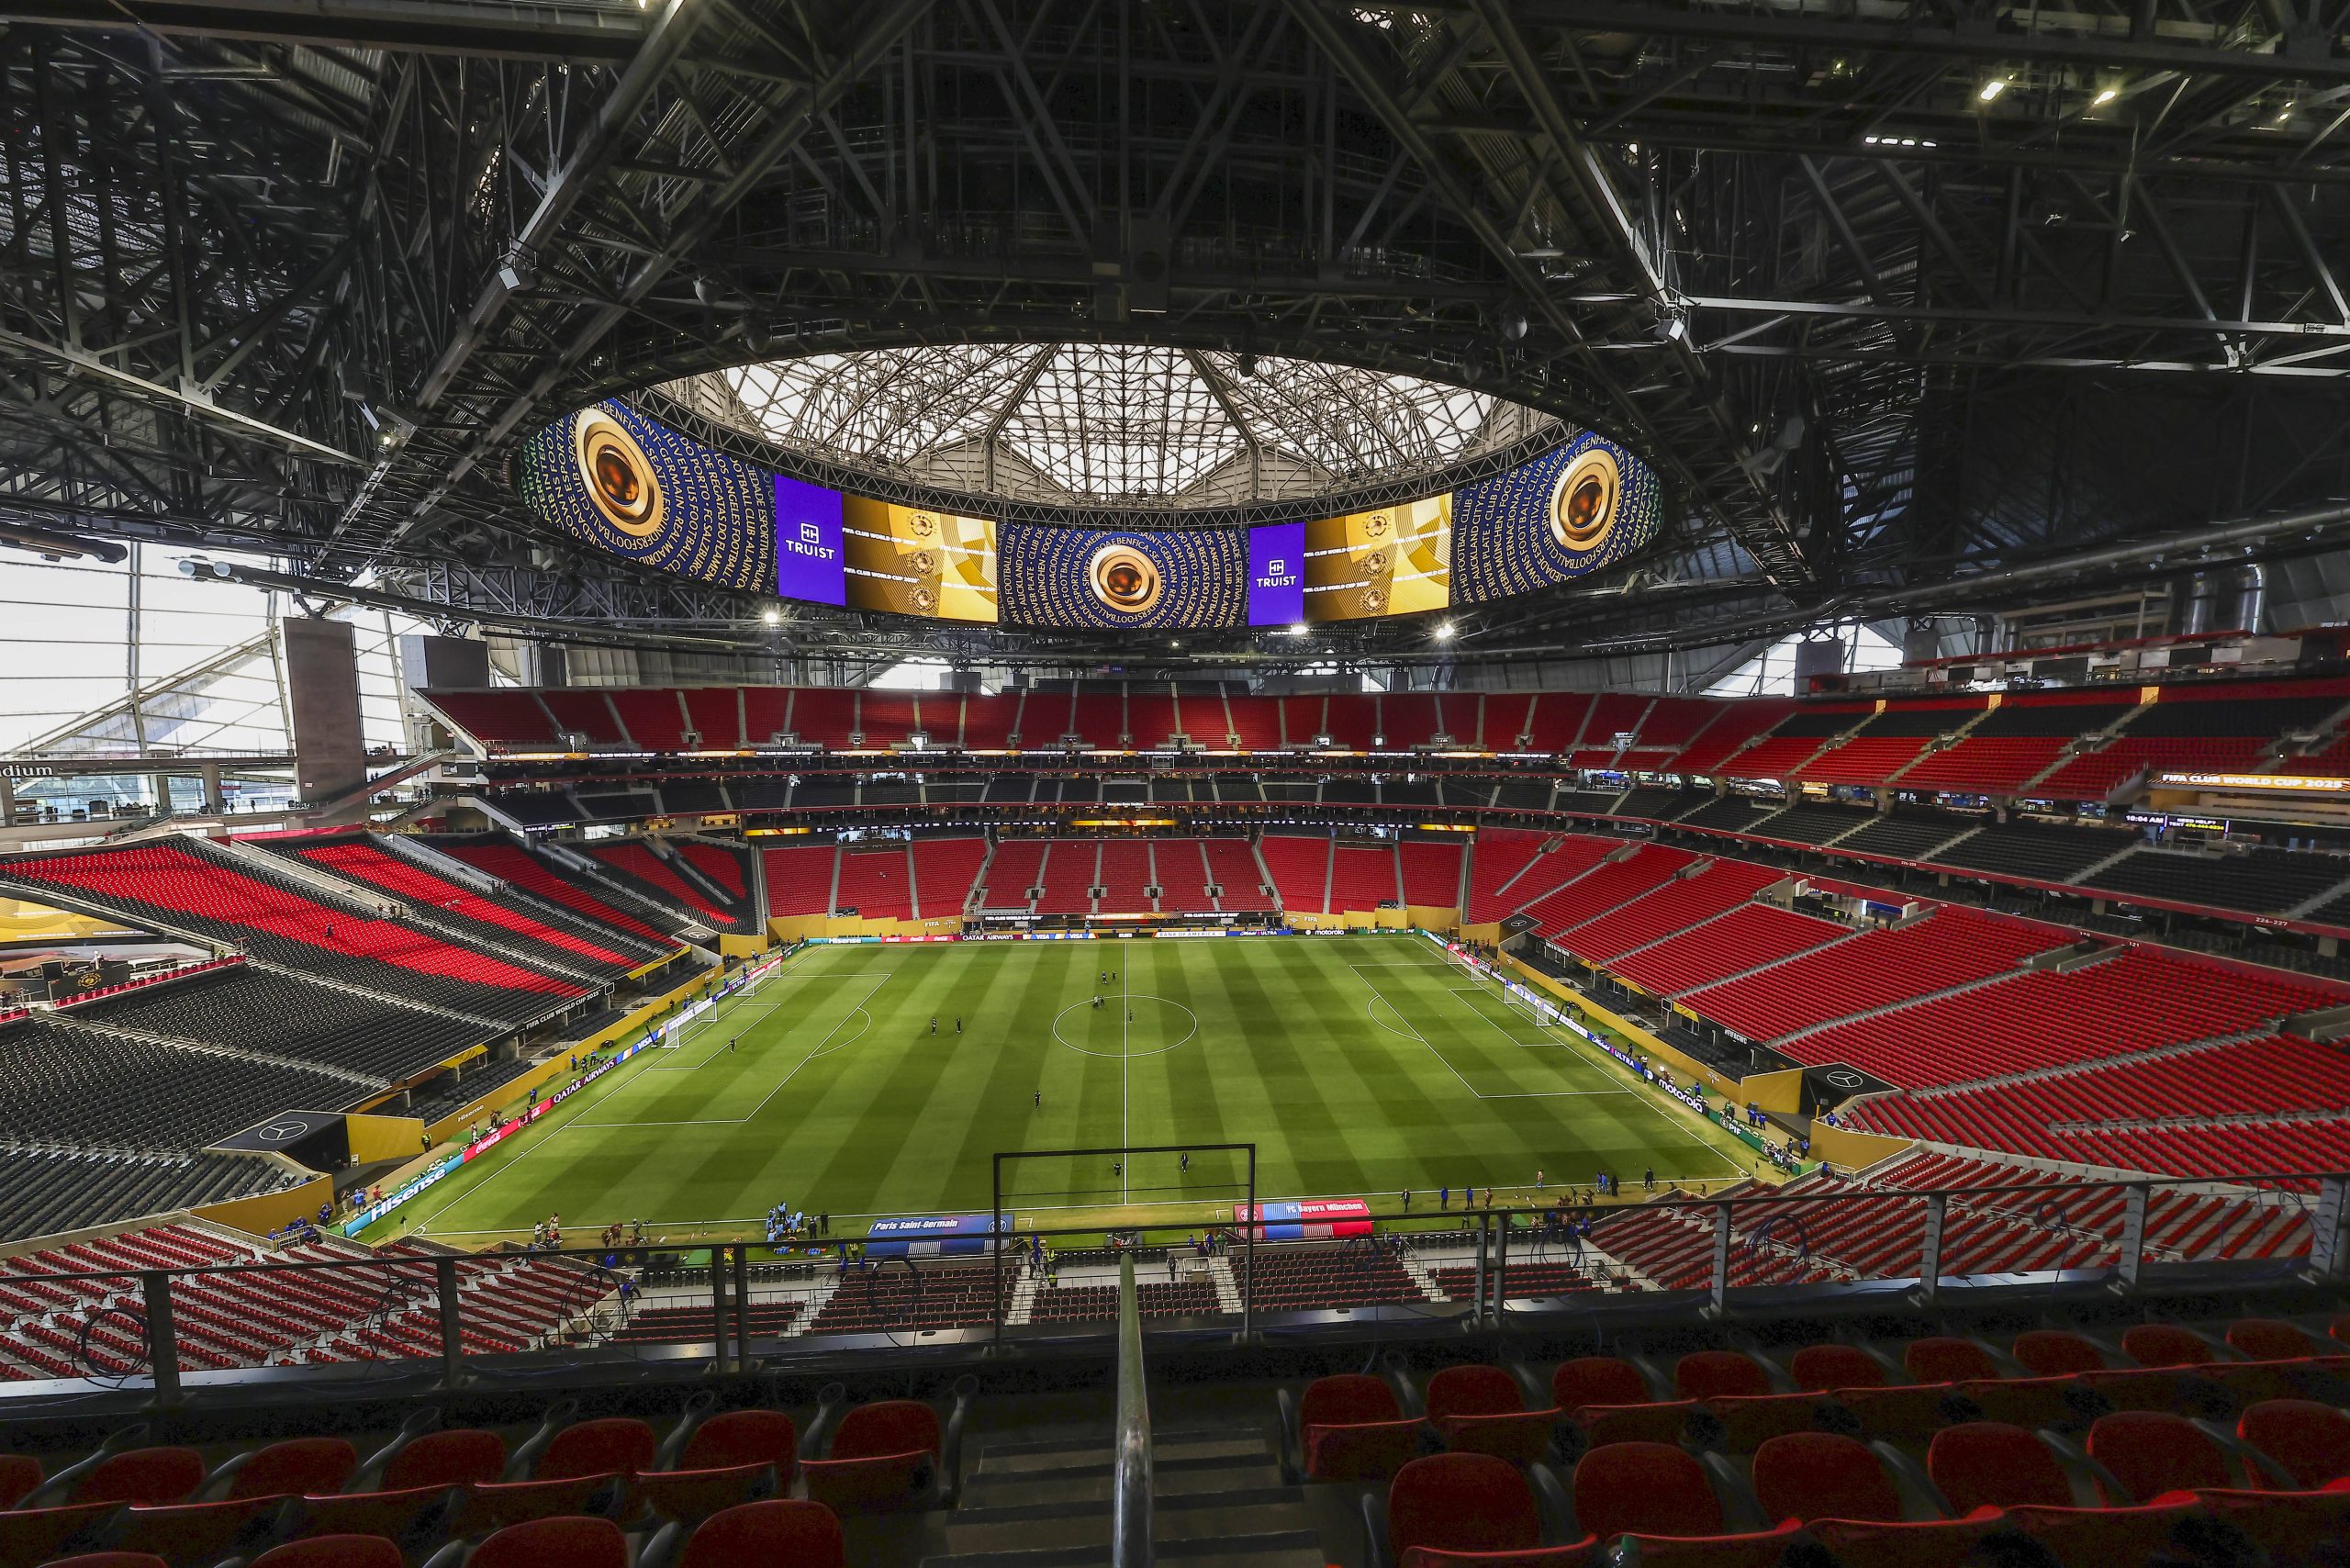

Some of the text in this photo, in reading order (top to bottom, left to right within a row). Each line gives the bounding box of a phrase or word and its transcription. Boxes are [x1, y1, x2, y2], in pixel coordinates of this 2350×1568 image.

[662, 432, 699, 562] JUVENTUS FOOTBALL
[689, 456, 713, 576] PORTO SALZBURG
[708, 471, 728, 521] REGATAS
[713, 453, 741, 577] LOS ANGELES FOOTBALL
[1460, 498, 1473, 523] CLUB
[1517, 461, 1547, 555] FOOTBALL CLUB
[1618, 490, 1633, 525] REAL
[1624, 461, 1642, 540] FOOTBALL
[667, 515, 685, 543] REAL
[757, 508, 769, 561] ESPORTIVA
[785, 538, 835, 560] TRUIST
[854, 529, 869, 537] CLUB
[869, 532, 890, 541] WORLD
[1457, 524, 1468, 573] FOOTBALL
[1482, 494, 1498, 560] PLATE CLUB
[1494, 516, 1504, 567] MÜNCHEN
[1506, 486, 1524, 571] INTERNACIONAL
[1530, 499, 1542, 559] ESPORTIVA
[1543, 534, 1559, 559] CLUB
[1003, 534, 1016, 610] HD FOOTBALL CLUB
[1015, 537, 1027, 606] AUCKLAND CITY
[1048, 532, 1069, 610] INTERNACIONAL DE
[1059, 532, 1084, 598] FOOTBALL CLUB
[1139, 531, 1177, 608] SAINT-GERMAIN REAL
[1192, 535, 1210, 582] DE REGATAS
[1327, 547, 1346, 555] WORLD
[1470, 524, 1482, 579] AUCKLAND
[1026, 540, 1042, 618] RIVER PLATE CLUB
[1037, 559, 1048, 602] MÜNCHEN
[1071, 561, 1084, 605] ESPORTIVA
[1084, 537, 1167, 624] BENFICA SEATTLE SOUNDERS FOOTBALL CLUB
[1163, 533, 1189, 620] JUVENTUS FOOTBALL
[1178, 543, 1199, 627] PORTO FC SALZBURG
[1203, 532, 1221, 622] LOS ANGELES FOOTBALL
[1224, 564, 1233, 585] CLUB
[1234, 560, 1243, 601] ESPORTIVA
[1256, 575, 1297, 588] TRUIST
[2162, 774, 2188, 782] FIFA
[2188, 775, 2221, 784] CLUB
[2222, 777, 2271, 786] WORLD
[2273, 778, 2303, 788] CUP
[2255, 917, 2288, 927] 226-227
[732, 979, 745, 990] ULTRA
[526, 1019, 540, 1029] FIFA
[540, 1012, 555, 1023] CLUB
[555, 1002, 576, 1016] WORLD
[576, 996, 587, 1005] CUP
[637, 1036, 653, 1050] VISA
[1615, 1049, 1635, 1067] ULTRA
[553, 1058, 615, 1103] QATAR AIRWAYS
[1658, 1079, 1704, 1114] motorola
[457, 1103, 485, 1123] Hisense
[1729, 1123, 1742, 1136] PIF
[475, 1130, 501, 1154] Coca-Cola
[371, 1168, 447, 1223] Hisense
[1287, 1203, 1363, 1214] FC Bayern München
[874, 1219, 958, 1231] Paris Saint-Germain
